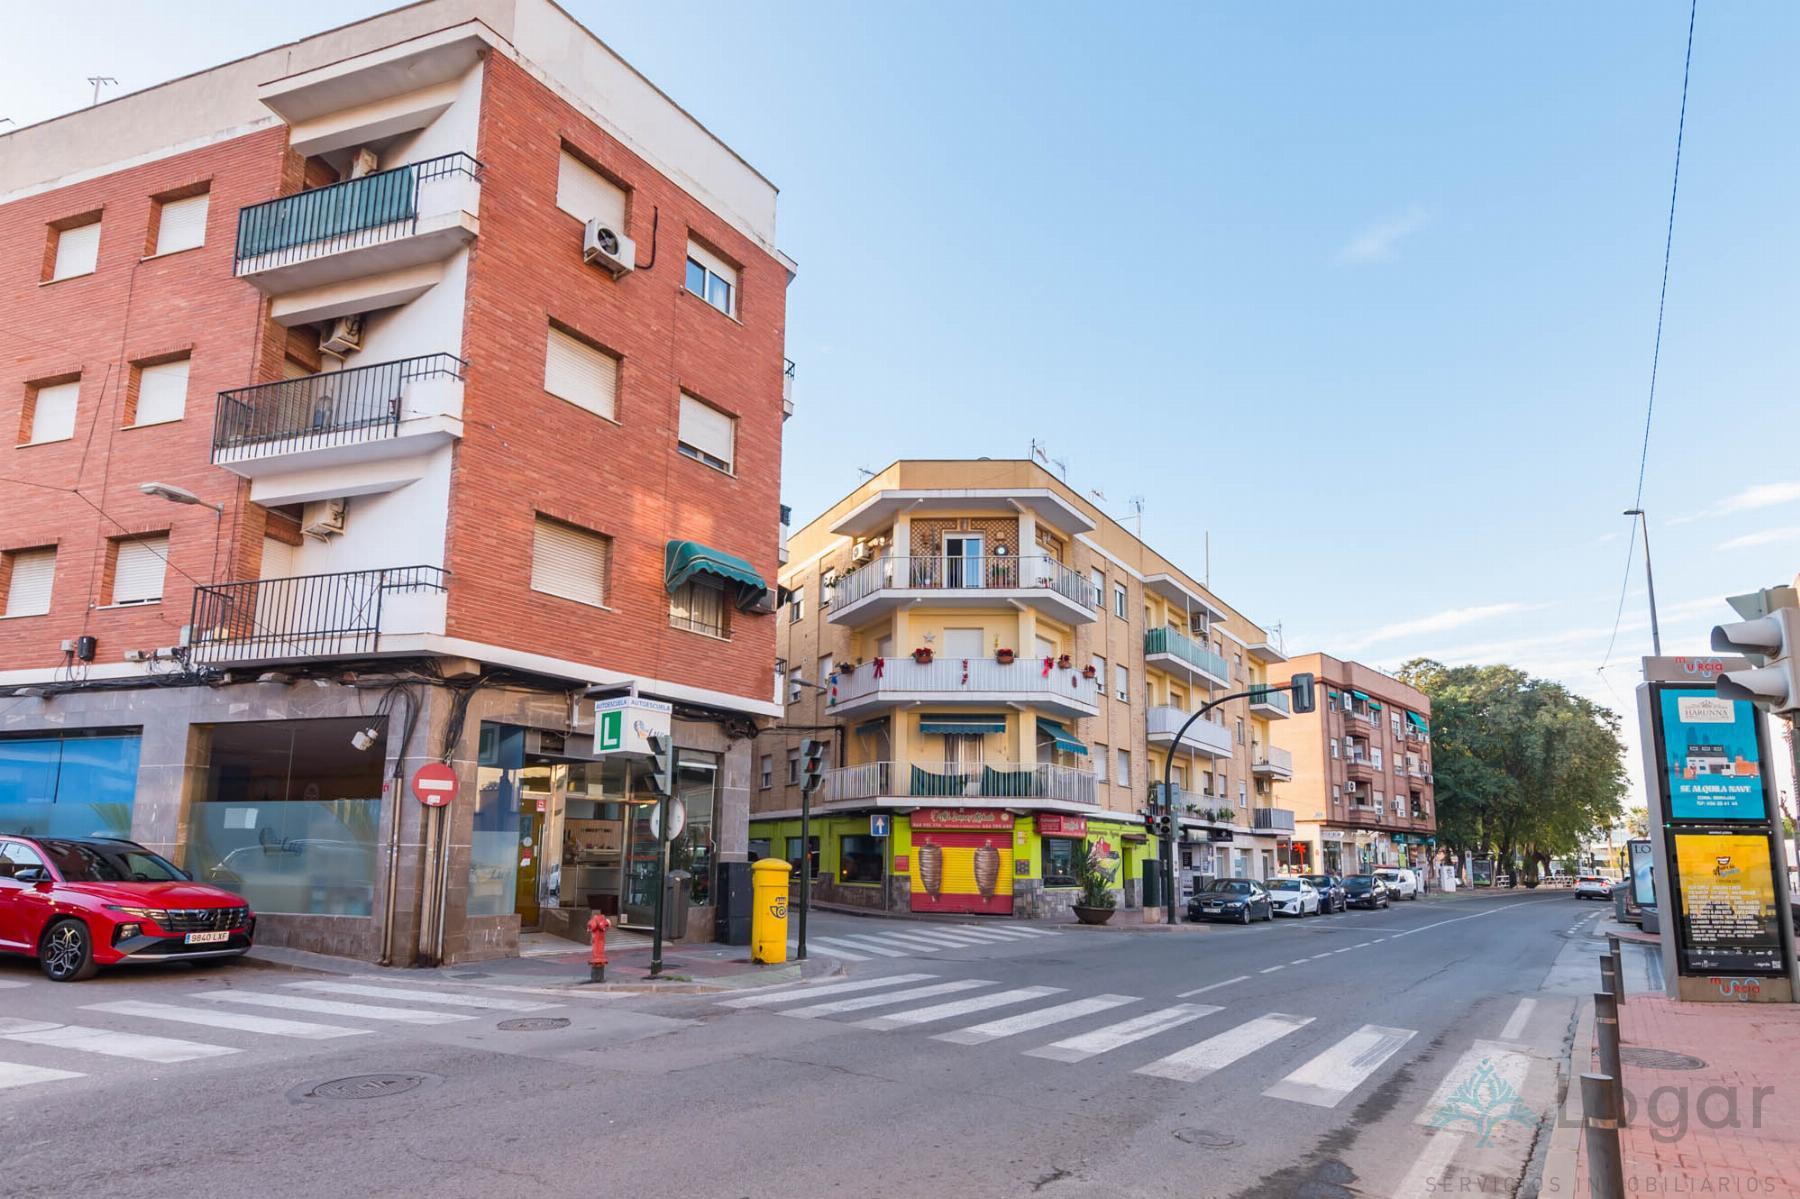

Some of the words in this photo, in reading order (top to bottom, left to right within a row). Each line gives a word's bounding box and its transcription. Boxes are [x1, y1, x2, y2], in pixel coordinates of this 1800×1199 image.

[596, 700, 627, 709] AUTOESCUELA
[631, 700, 671, 711] AUTOESCUELA
[603, 717, 618, 746] L
[1692, 785, 1728, 794] ALQUILA
[191, 933, 211, 942] 9840
